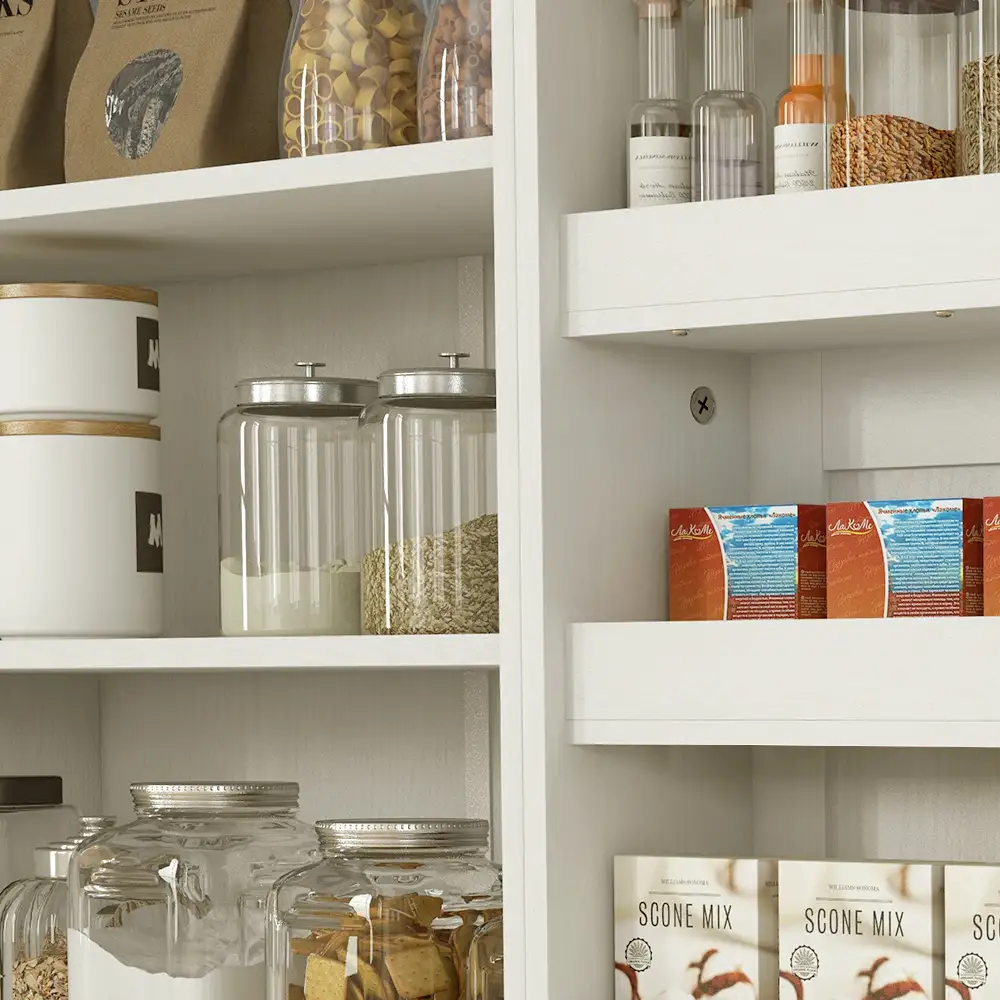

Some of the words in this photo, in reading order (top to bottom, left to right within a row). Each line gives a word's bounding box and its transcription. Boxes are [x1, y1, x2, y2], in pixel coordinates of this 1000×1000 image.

[115, 8, 141, 18] SESAME
[143, 4, 166, 14] SEEDS
[639, 901, 694, 928] SCONE
[703, 904, 732, 930] MIX
[805, 907, 864, 935] SCONE
[872, 910, 905, 937] MIX
